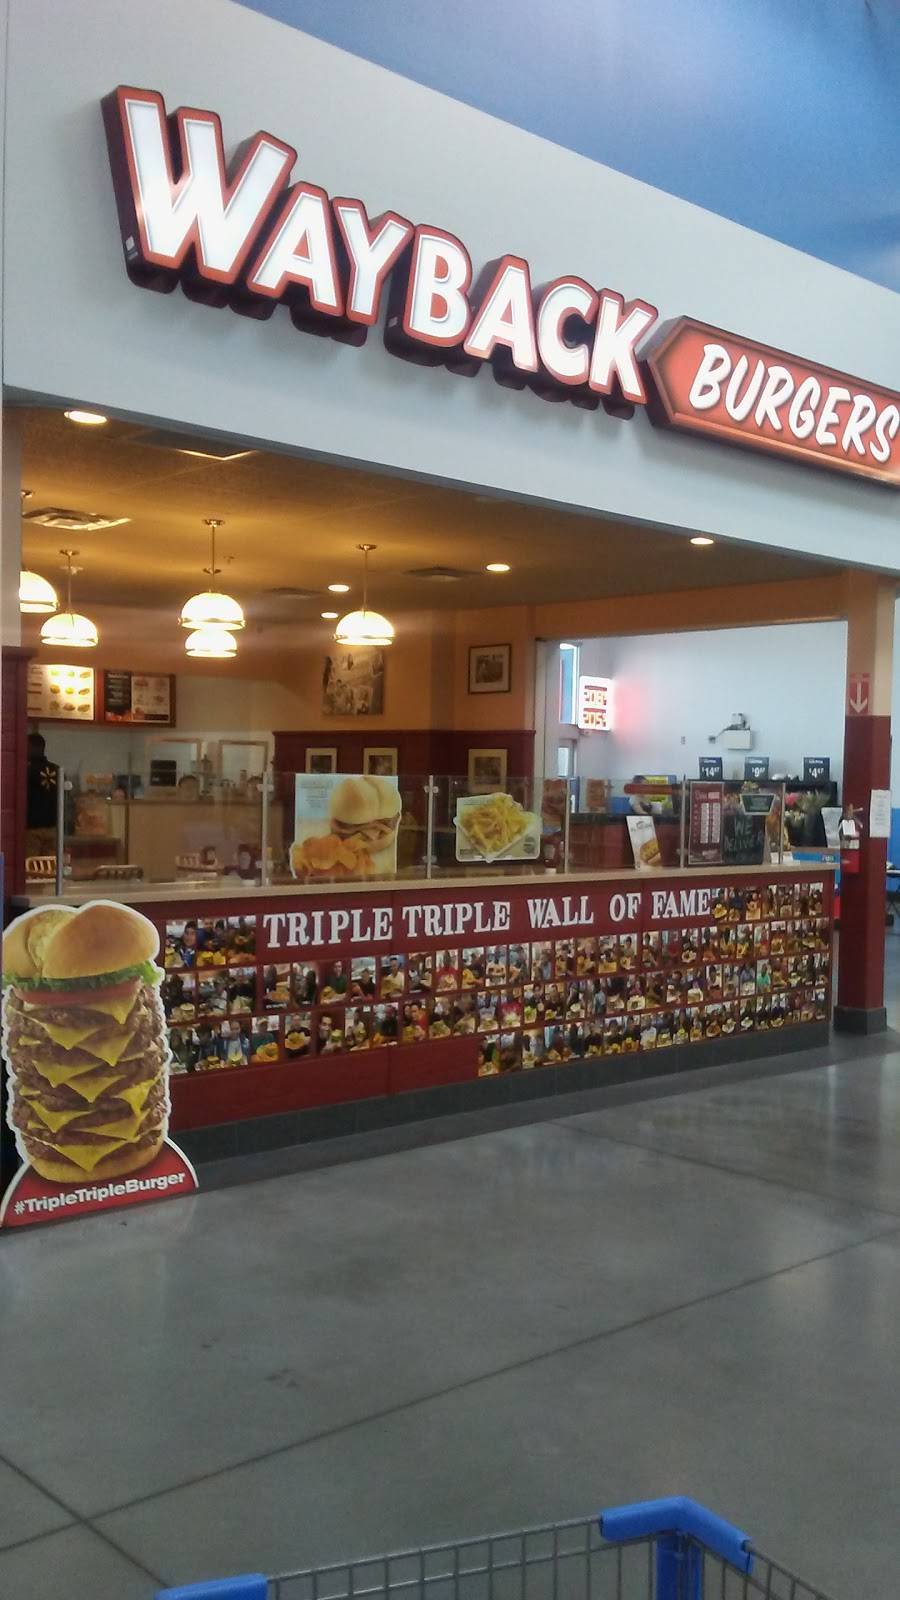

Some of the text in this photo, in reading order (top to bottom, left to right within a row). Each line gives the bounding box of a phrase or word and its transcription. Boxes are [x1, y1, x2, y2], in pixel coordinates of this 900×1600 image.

[112, 86, 658, 406] WAYBACK
[688, 343, 900, 463] BURGERS
[262, 888, 711, 949] TRIPLE TRIPLE WALL OF FAME
[13, 1171, 186, 1216] #TripleTripleBurger
